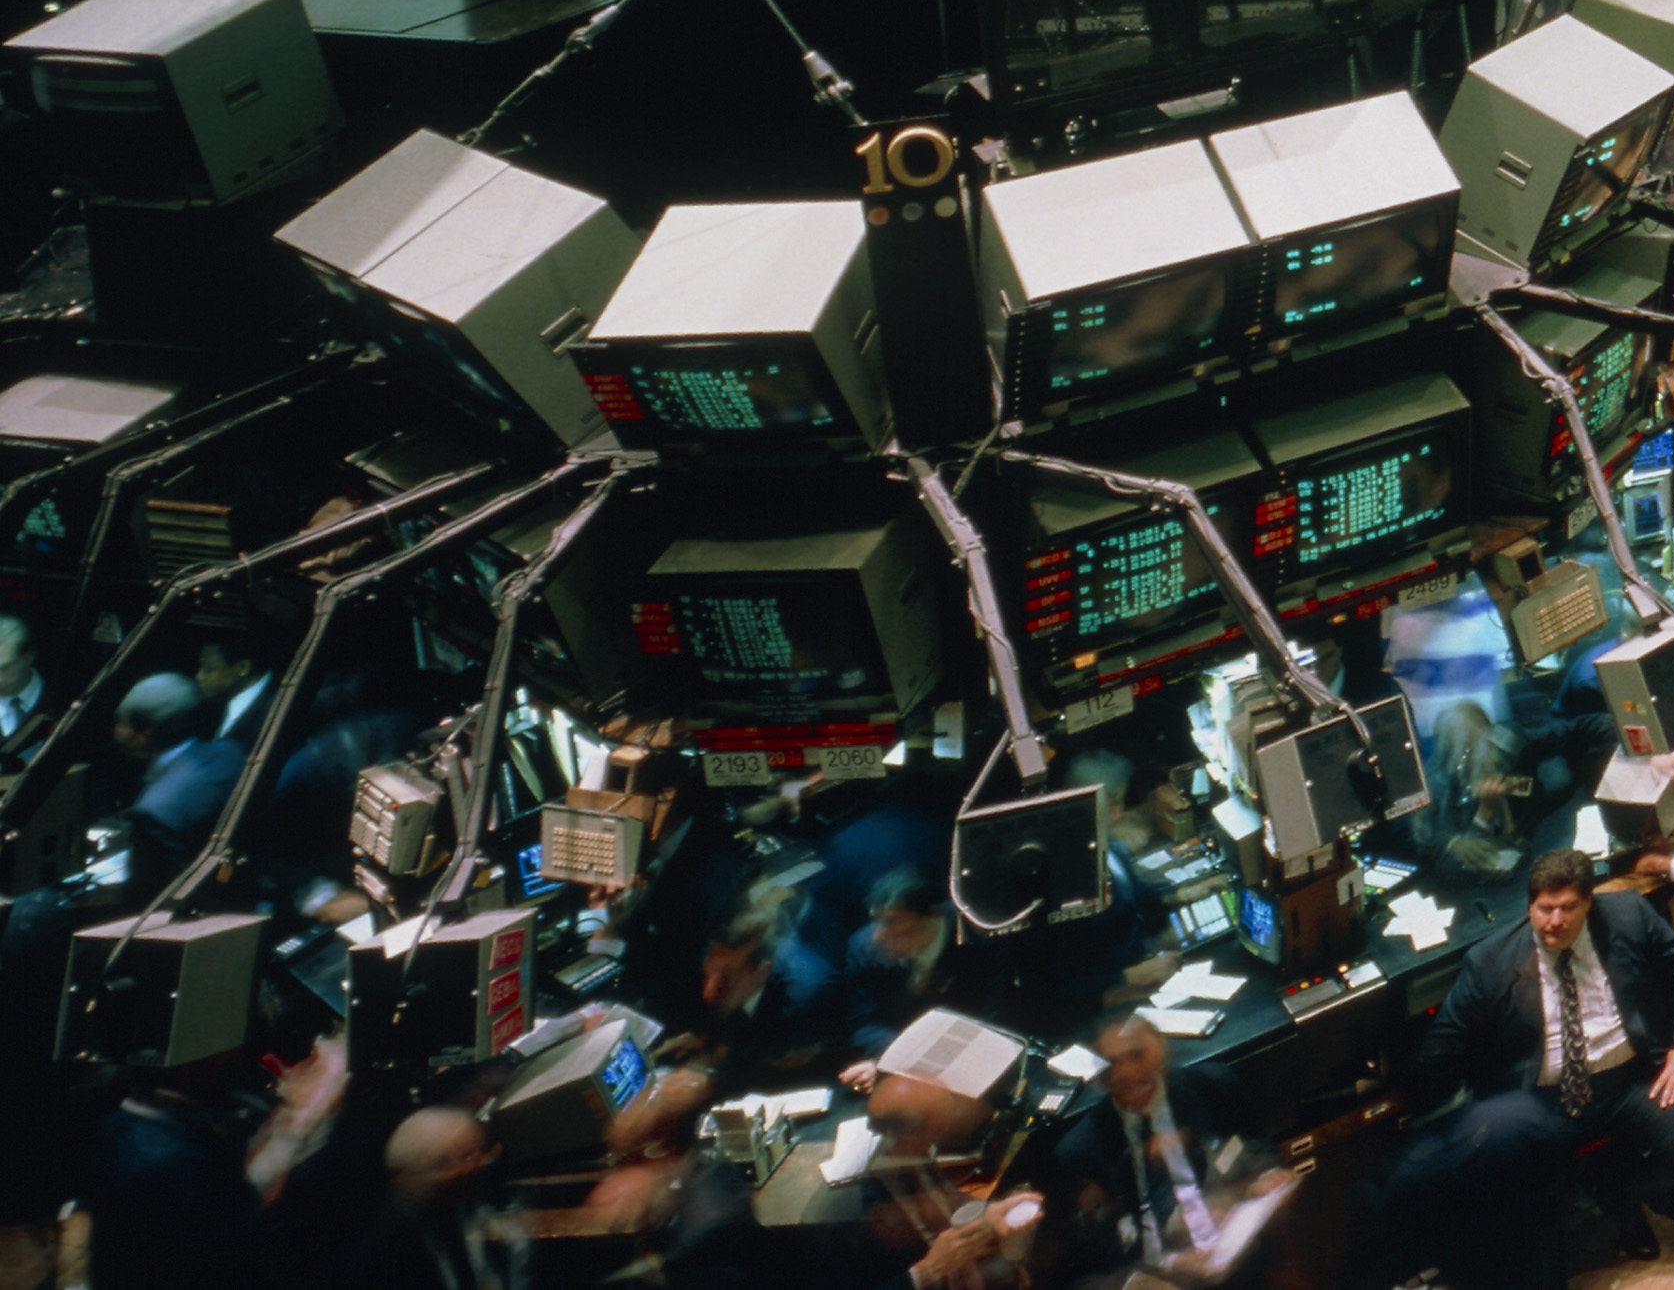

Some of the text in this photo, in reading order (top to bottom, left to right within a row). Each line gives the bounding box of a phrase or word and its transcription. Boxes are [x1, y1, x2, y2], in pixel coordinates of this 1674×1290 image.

[855, 126, 954, 194] 10
[1405, 575, 1450, 600] 2489
[711, 756, 761, 773] 2193
[826, 747, 876, 767] 2060
